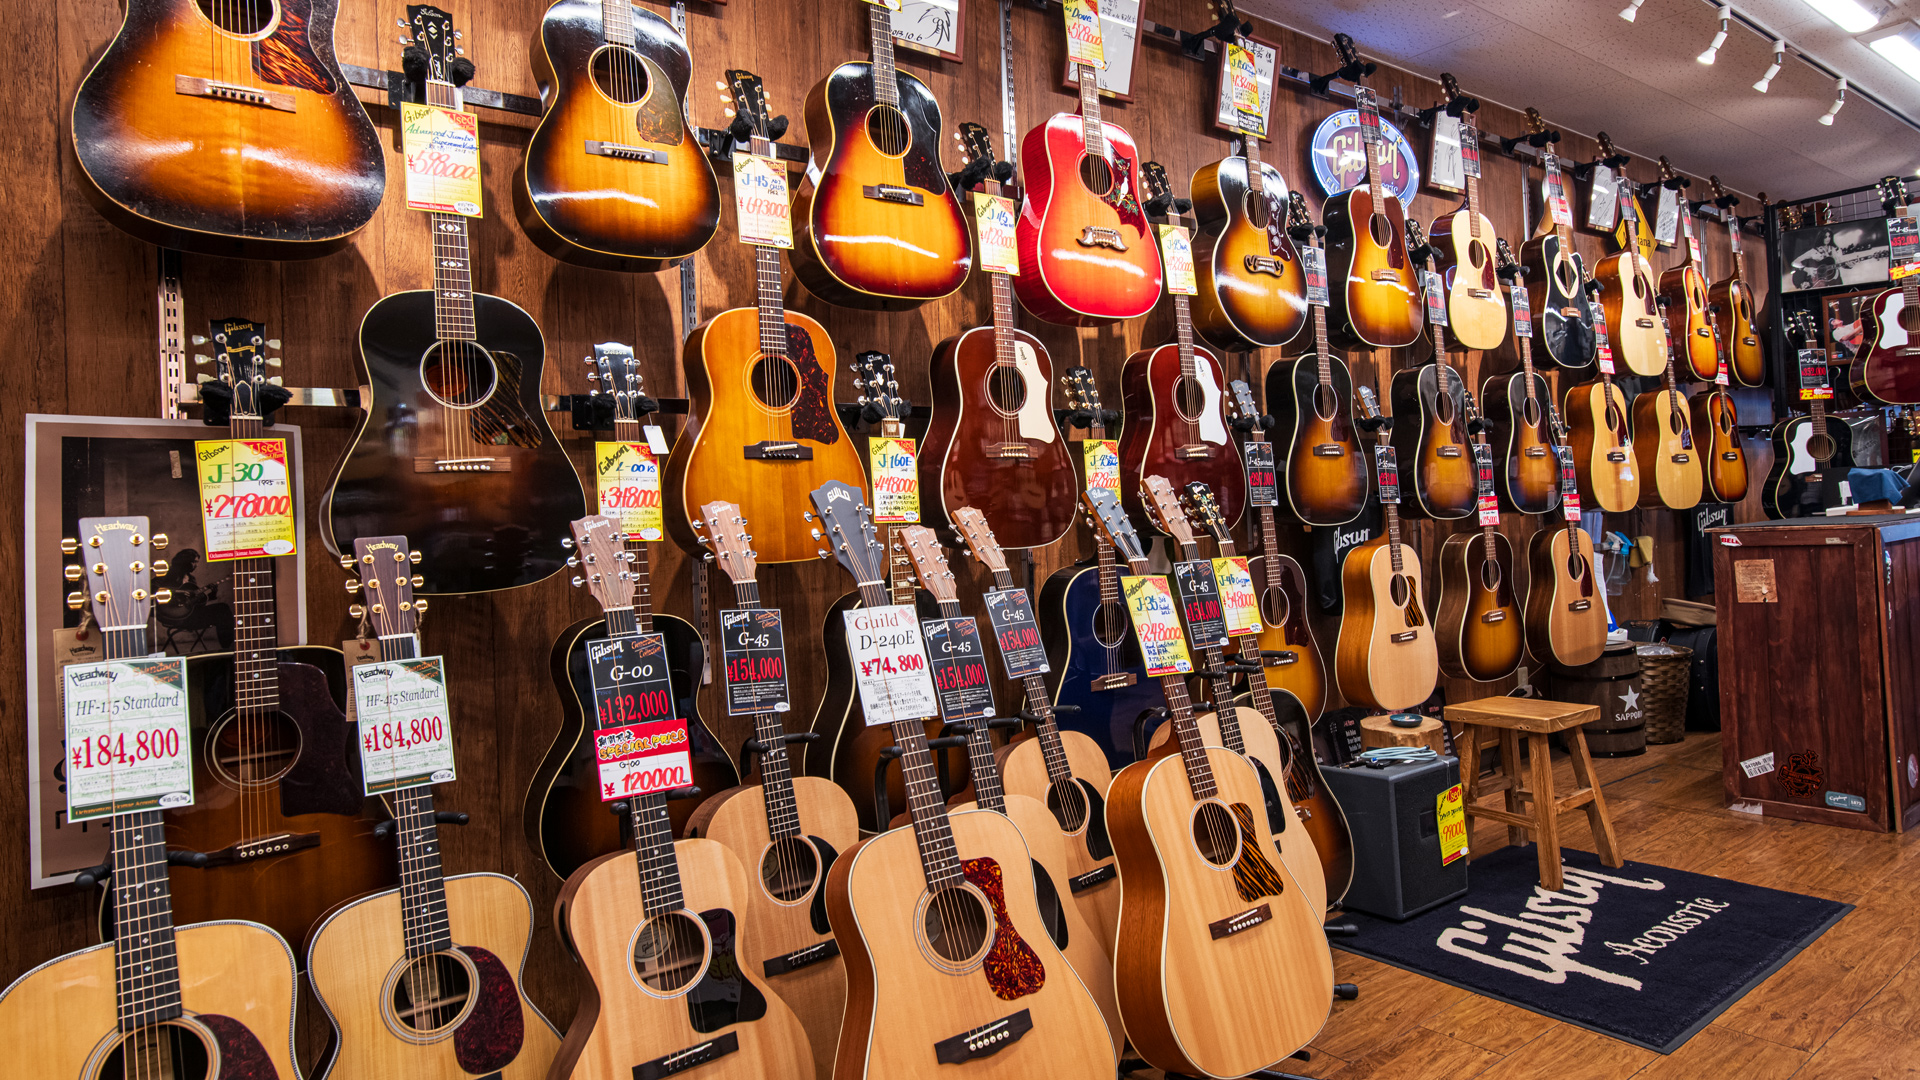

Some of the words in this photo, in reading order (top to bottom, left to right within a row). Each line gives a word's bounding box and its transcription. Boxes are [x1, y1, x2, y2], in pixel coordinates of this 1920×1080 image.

[1072, 8, 1092, 22] Dove
[404, 108, 434, 123] Gibson
[447, 114, 474, 124] Used
[735, 158, 754, 172] Gibson
[742, 173, 768, 188] J-45
[224, 323, 254, 336] Gibson
[868, 354, 883, 362] Gibson
[198, 444, 230, 462] Gibson
[250, 442, 281, 456] Used
[634, 446, 650, 456] Use
[872, 440, 890, 456] Gibson
[598, 444, 630, 476] Gibson
[878, 454, 912, 468] J-160E
[208, 462, 264, 484] J-30
[826, 486, 851, 503] GUILD
[1091, 488, 1110, 499] Gibson
[205, 493, 291, 518] ¥278,000
[711, 504, 732, 517] Gibson
[94, 520, 138, 534] Headway
[584, 518, 610, 533] Gibson
[1697, 507, 1728, 537] Gibson
[366, 540, 398, 554] Headway
[1176, 563, 1195, 579] Gibson
[1125, 578, 1148, 598] Gibson
[1188, 580, 1209, 592] G-45
[988, 592, 1008, 610] Gibson
[1002, 610, 1024, 620] G-45
[1186, 600, 1220, 622] ¥154,000
[724, 612, 750, 630] Gibson
[855, 613, 898, 630] Guild
[926, 622, 950, 640] Gibson
[738, 632, 770, 648] G-45
[860, 630, 914, 650] D-240E
[942, 642, 972, 652] G-45
[999, 628, 1039, 651] ¥154,000
[591, 640, 624, 665] Gibson
[358, 666, 394, 682] Headway
[727, 656, 782, 682] ¥154,000
[936, 664, 986, 690] ¥154,000
[70, 667, 118, 688] Headway
[123, 691, 180, 711] Standard
[400, 686, 440, 702] Standard
[598, 690, 669, 725] ¥132,000
[71, 726, 94, 734] Price
[364, 716, 442, 752] ¥184,800
[72, 728, 179, 770] ¥184,800
[599, 738, 651, 760] SPECIAL
[651, 728, 687, 748] PRICE
[619, 760, 640, 768] G-00
[1436, 866, 1665, 991] Gibson
[1604, 898, 1730, 965] Acoustic
